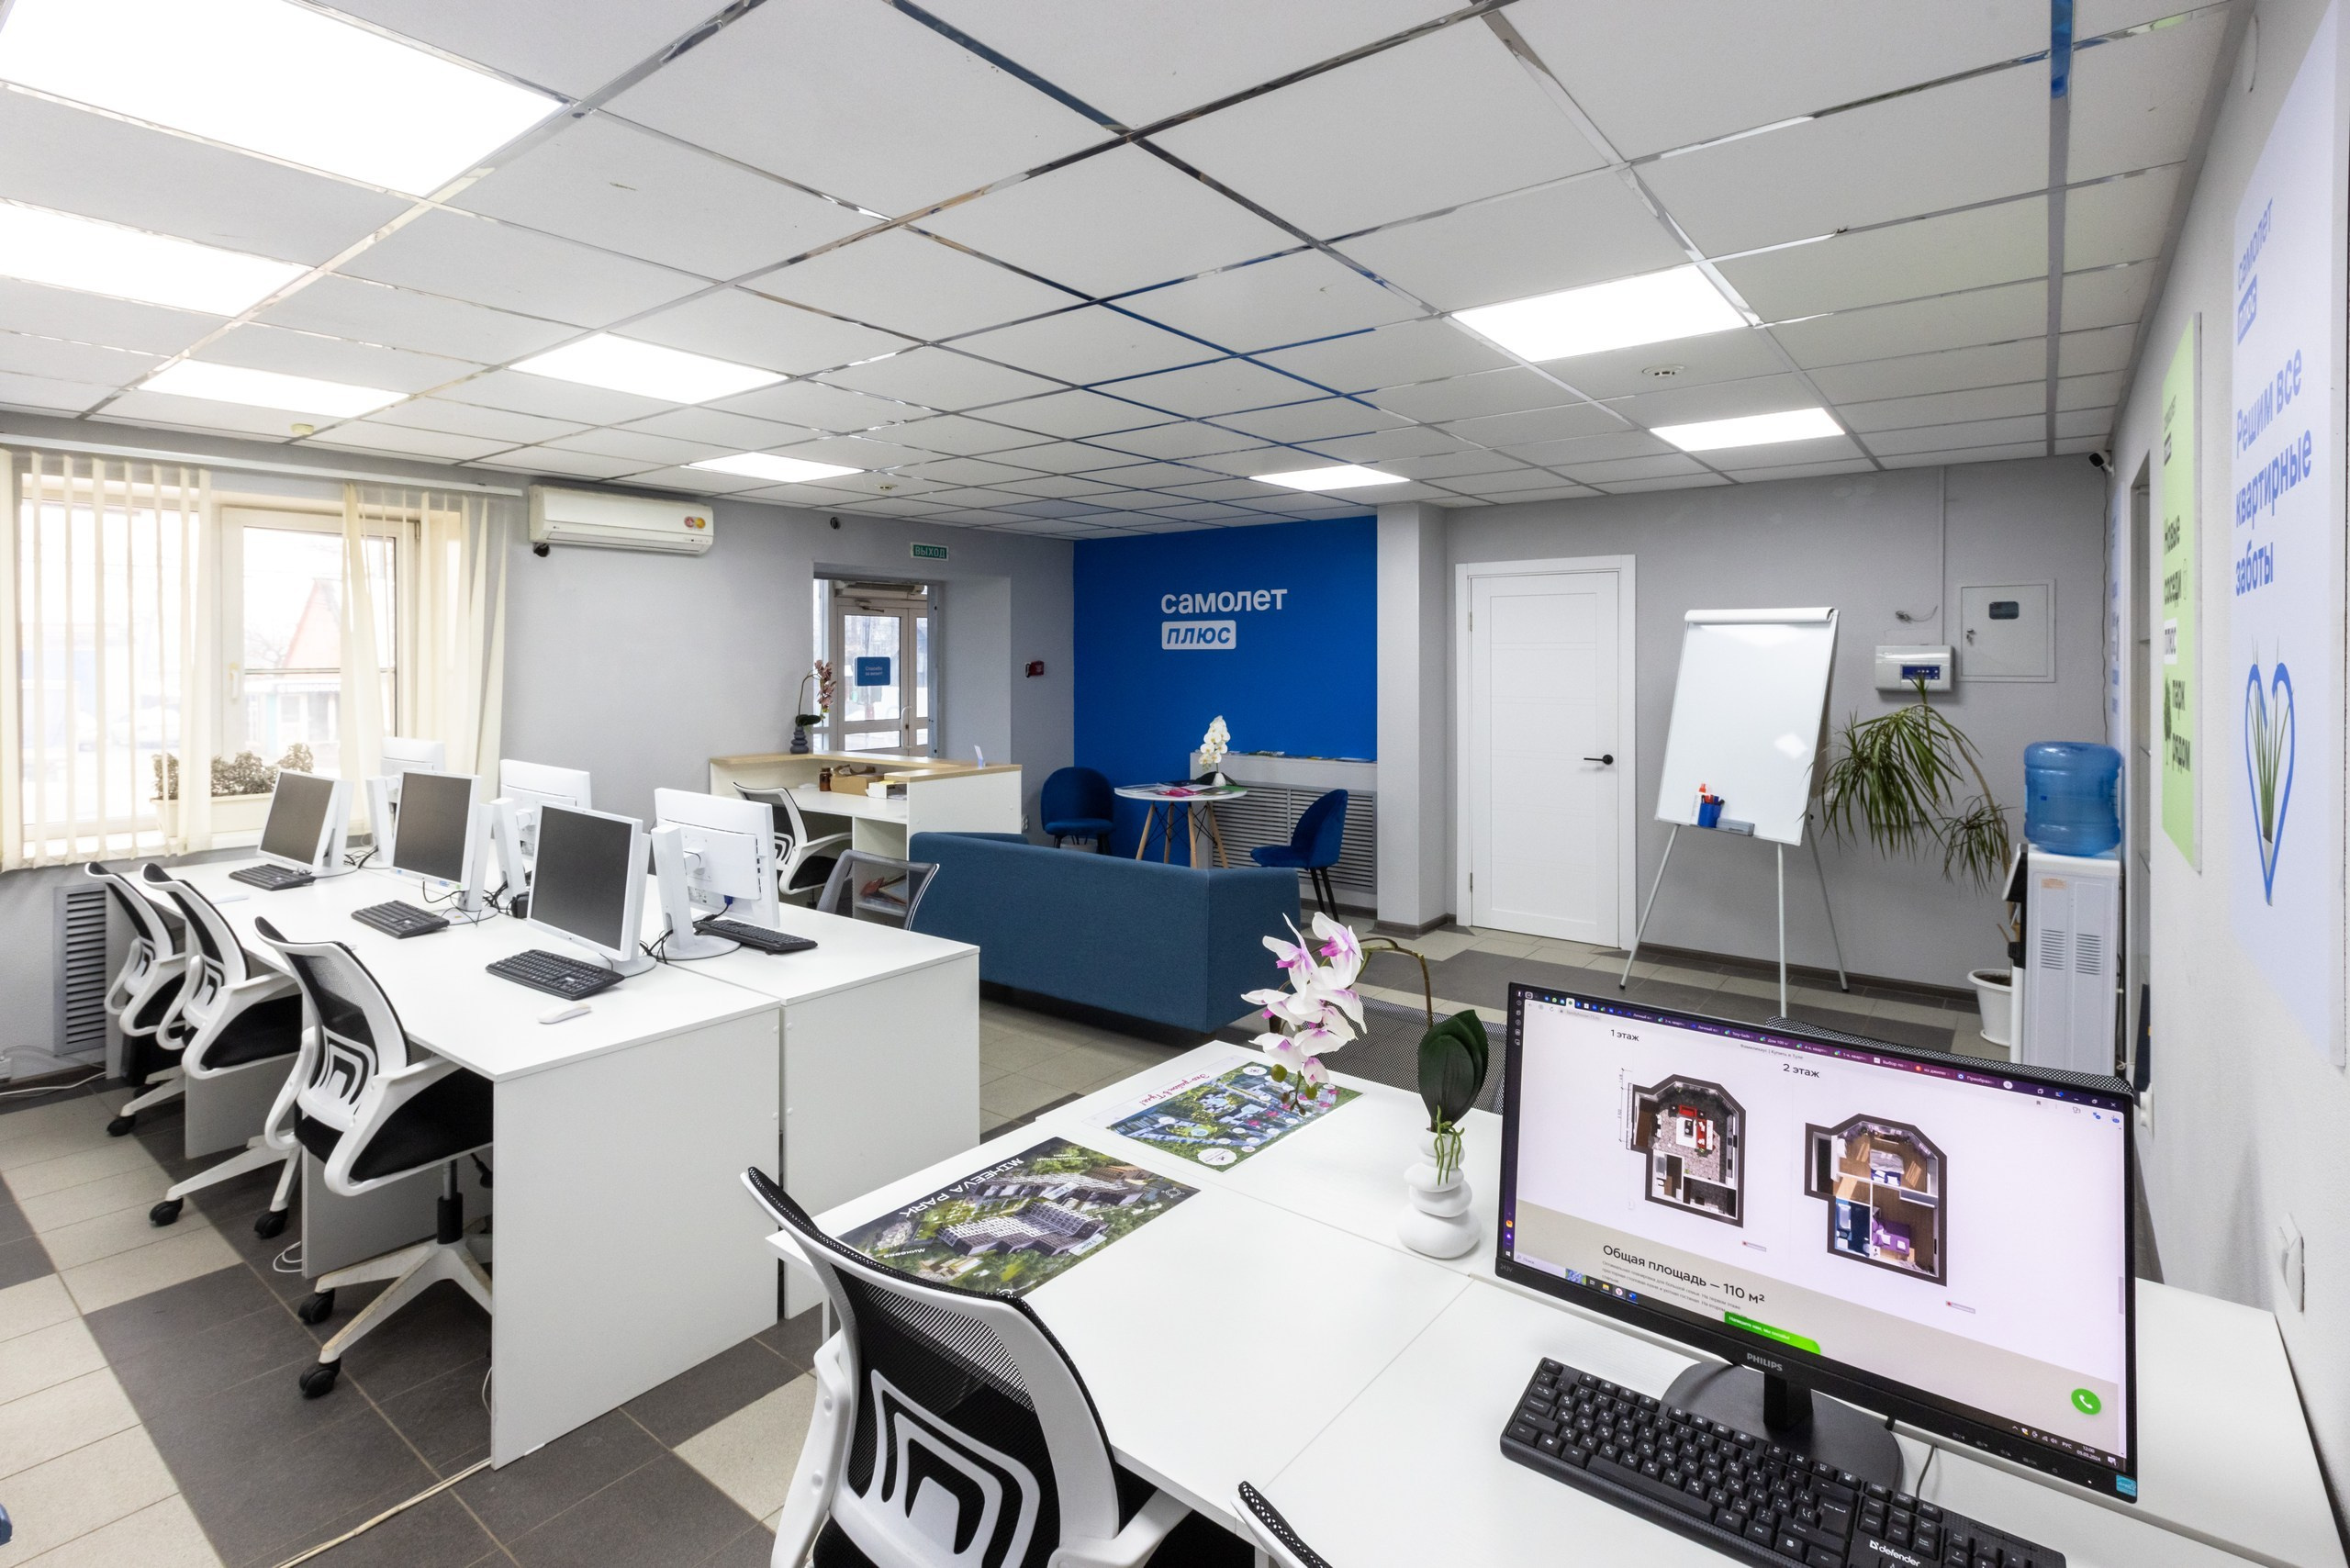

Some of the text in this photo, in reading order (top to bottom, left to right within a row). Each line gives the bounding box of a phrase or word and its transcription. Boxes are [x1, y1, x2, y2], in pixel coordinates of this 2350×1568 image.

[2238, 196, 2273, 291] самолет
[2237, 349, 2301, 459] Решим все
[2236, 430, 2311, 530] квартирные
[915, 546, 946, 558] ВЫХОД
[2235, 539, 2274, 597] заботы
[1161, 588, 1287, 614] самолет
[1167, 627, 1231, 644] плюс
[1617, 1032, 1639, 1042] этаж
[1783, 1063, 1819, 1079] 2 этаж
[899, 1158, 1024, 1218] MIHEEVA PARK
[1603, 1245, 1645, 1267] Общая
[1649, 1260, 1707, 1288] площадь
[1723, 1283, 1744, 1299] 110
[1749, 1294, 1765, 1304] м²
[1747, 1353, 1783, 1372] PHILIPS
[1879, 1545, 1920, 1566] defender
